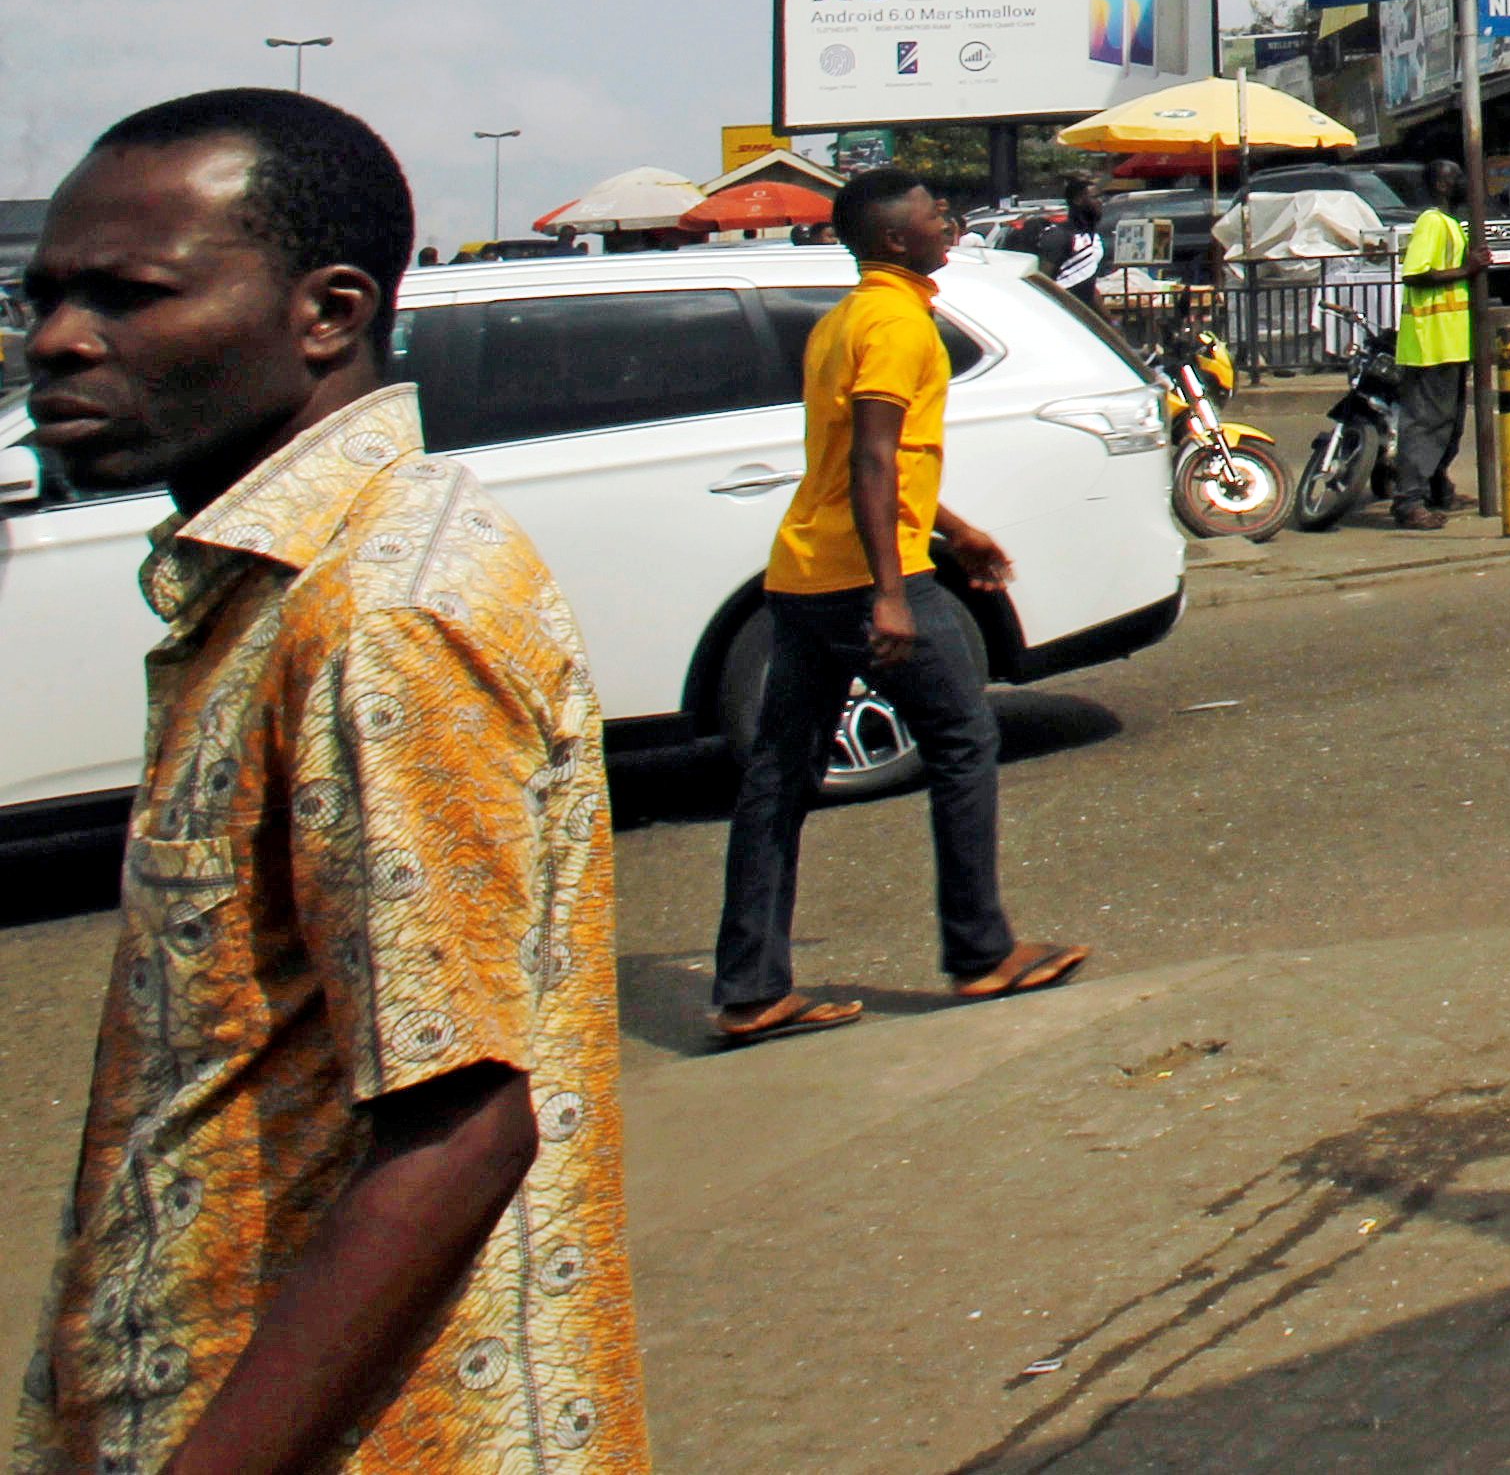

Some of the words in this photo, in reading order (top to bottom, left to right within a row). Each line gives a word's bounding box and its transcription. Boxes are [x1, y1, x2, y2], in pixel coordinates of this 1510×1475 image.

[810, 8, 883, 24] Android
[888, 8, 916, 22] 6.0
[920, 5, 1037, 21] Marshmallow
